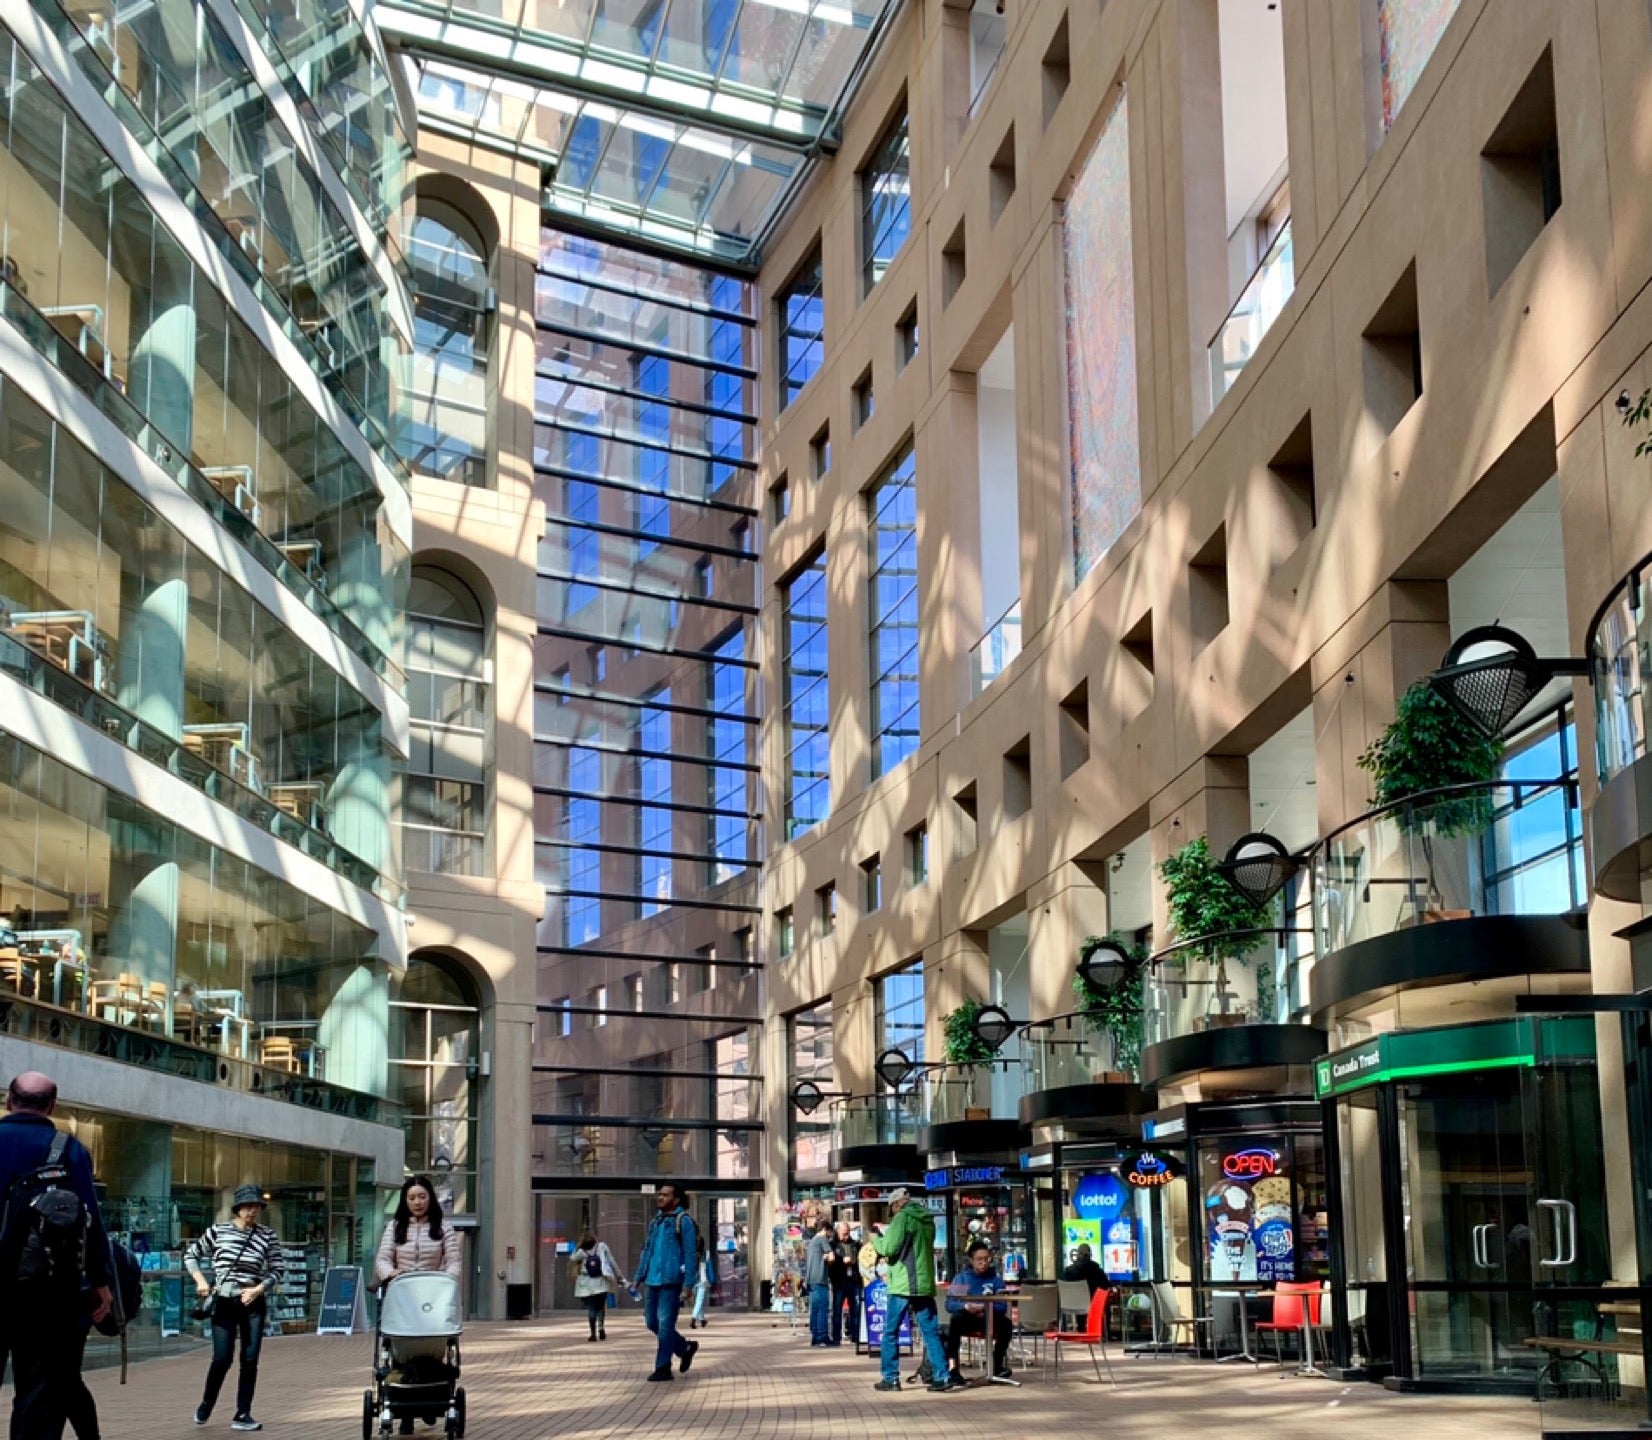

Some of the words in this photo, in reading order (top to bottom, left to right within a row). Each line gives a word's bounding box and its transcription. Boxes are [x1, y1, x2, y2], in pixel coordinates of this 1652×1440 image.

[1333, 1057, 1359, 1077] Canada
[1358, 1050, 1380, 1068] Trust
[1223, 1154, 1274, 1173] OPEN
[1128, 1170, 1175, 1185] COFFEE
